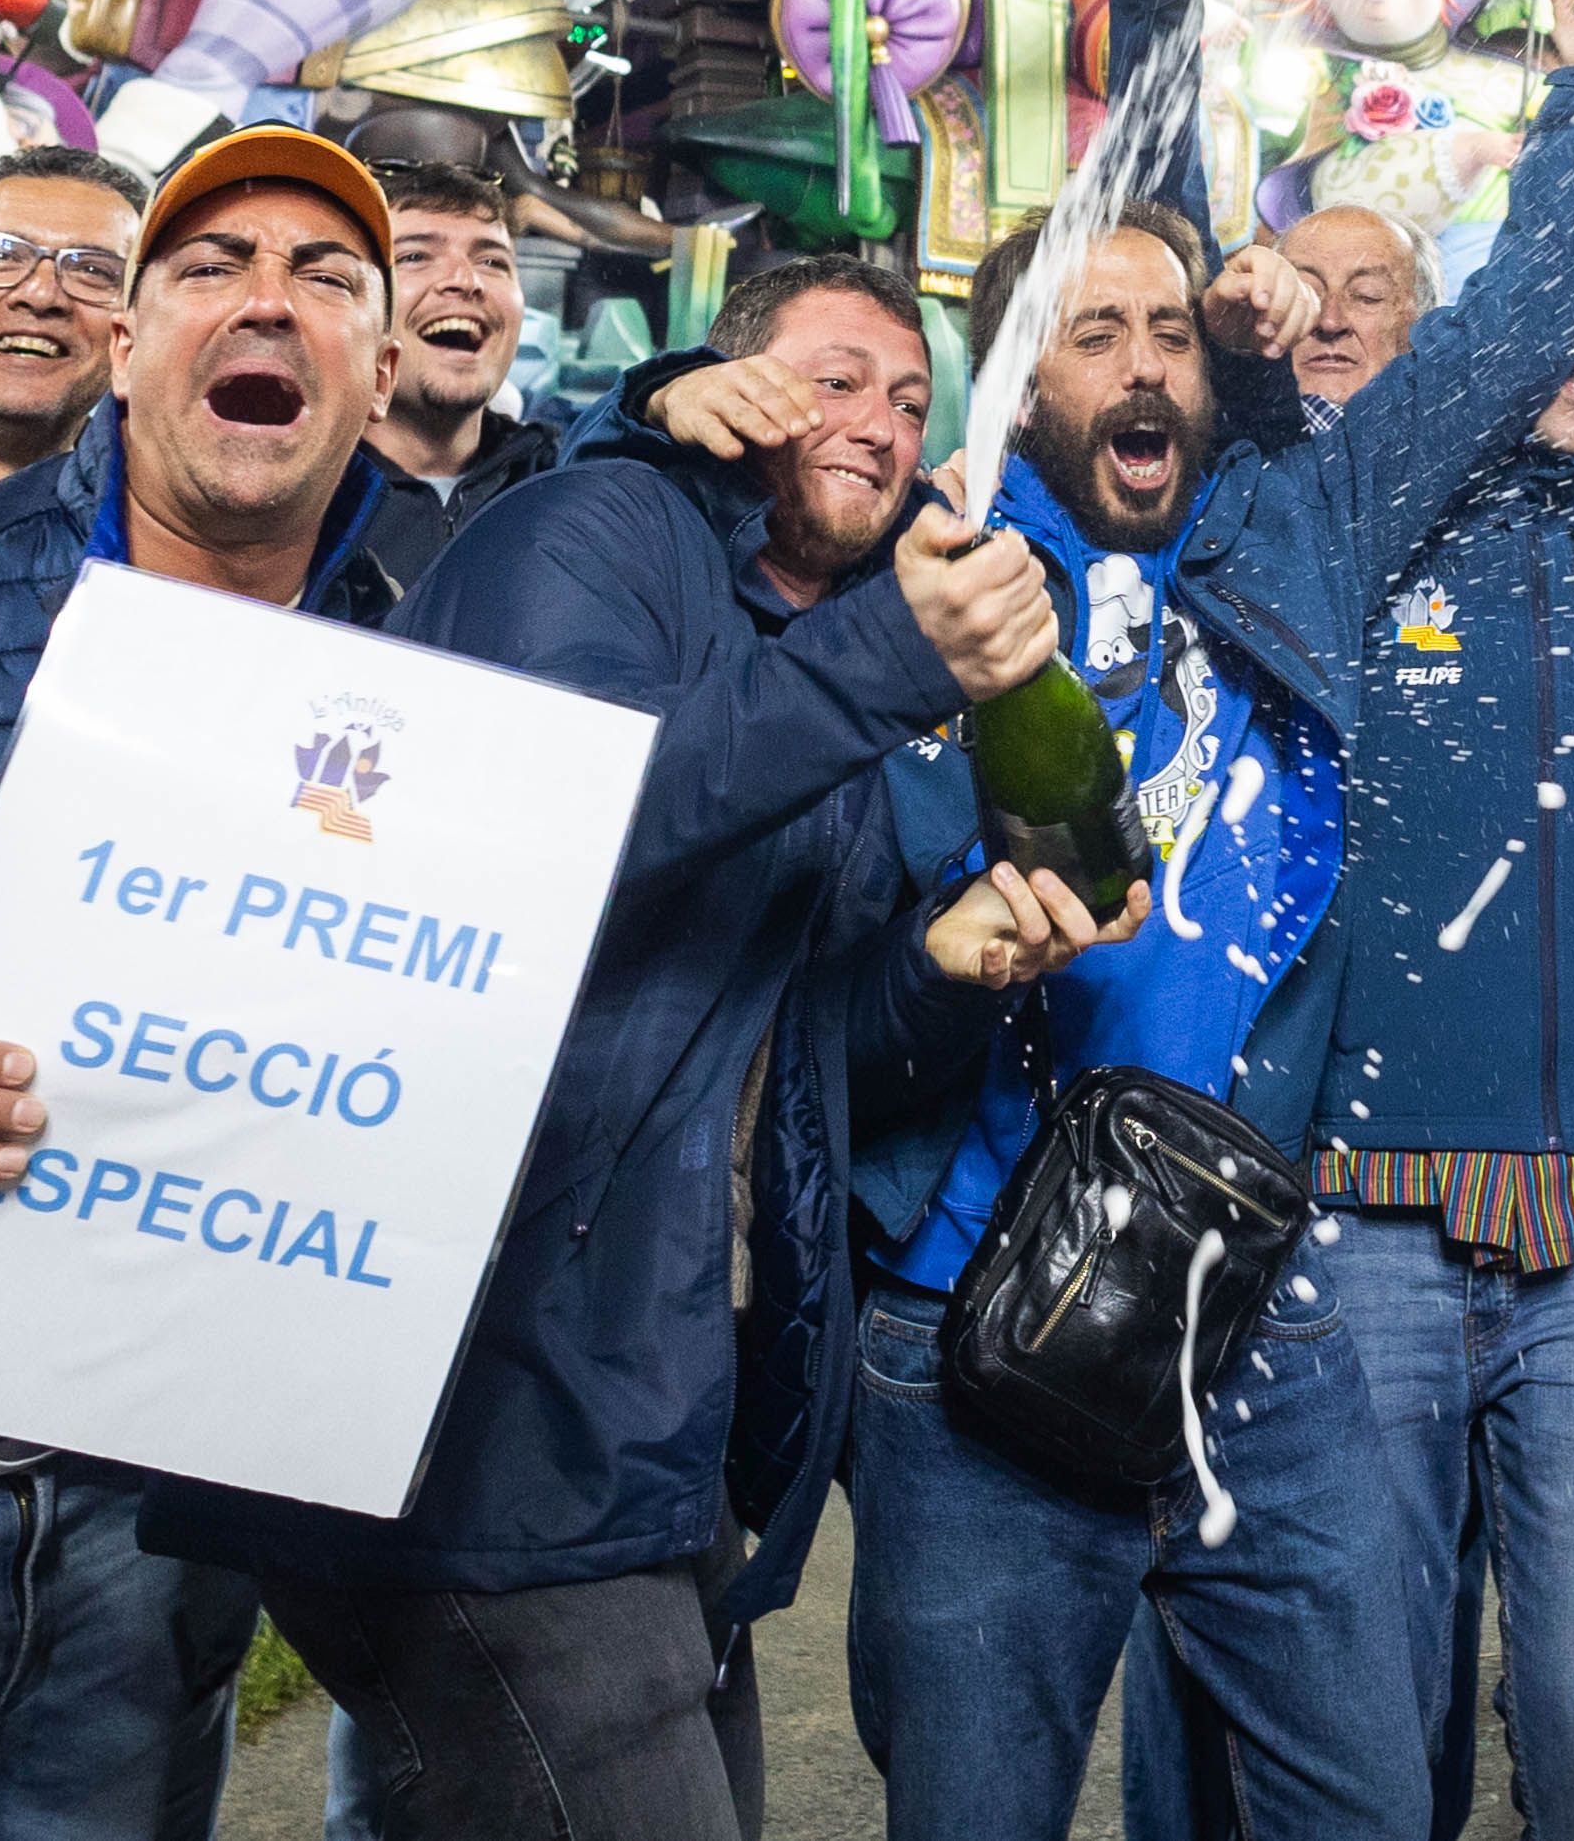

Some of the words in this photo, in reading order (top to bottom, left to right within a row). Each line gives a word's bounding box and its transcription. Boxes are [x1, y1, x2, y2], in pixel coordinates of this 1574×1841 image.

[1395, 666, 1464, 686] FELIPE
[77, 839, 208, 922] 1er
[223, 873, 503, 994] PREMI
[60, 1000, 402, 1128] SECCIÓ
